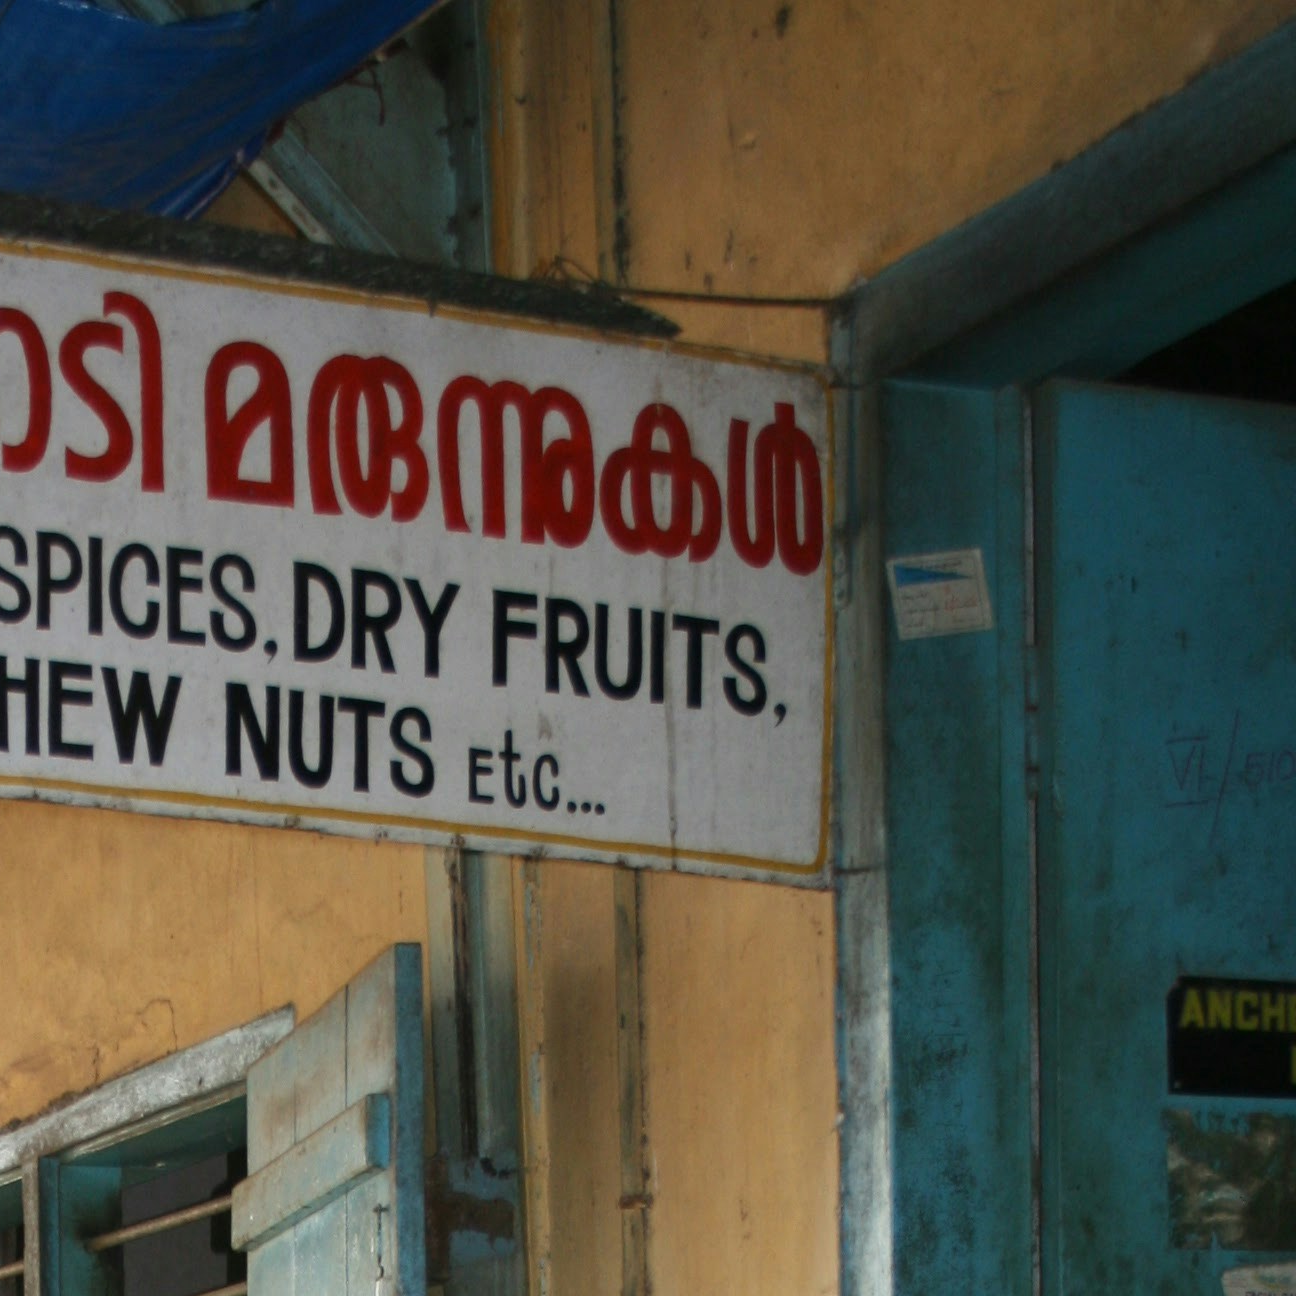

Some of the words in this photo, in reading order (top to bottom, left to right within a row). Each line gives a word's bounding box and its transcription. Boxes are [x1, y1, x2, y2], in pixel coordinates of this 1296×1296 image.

[204, 340, 824, 577] മരുന്നുകൾ
[292, 560, 461, 679] DRY
[491, 588, 788, 728] FRUITS,
[224, 681, 435, 799] NUTS
